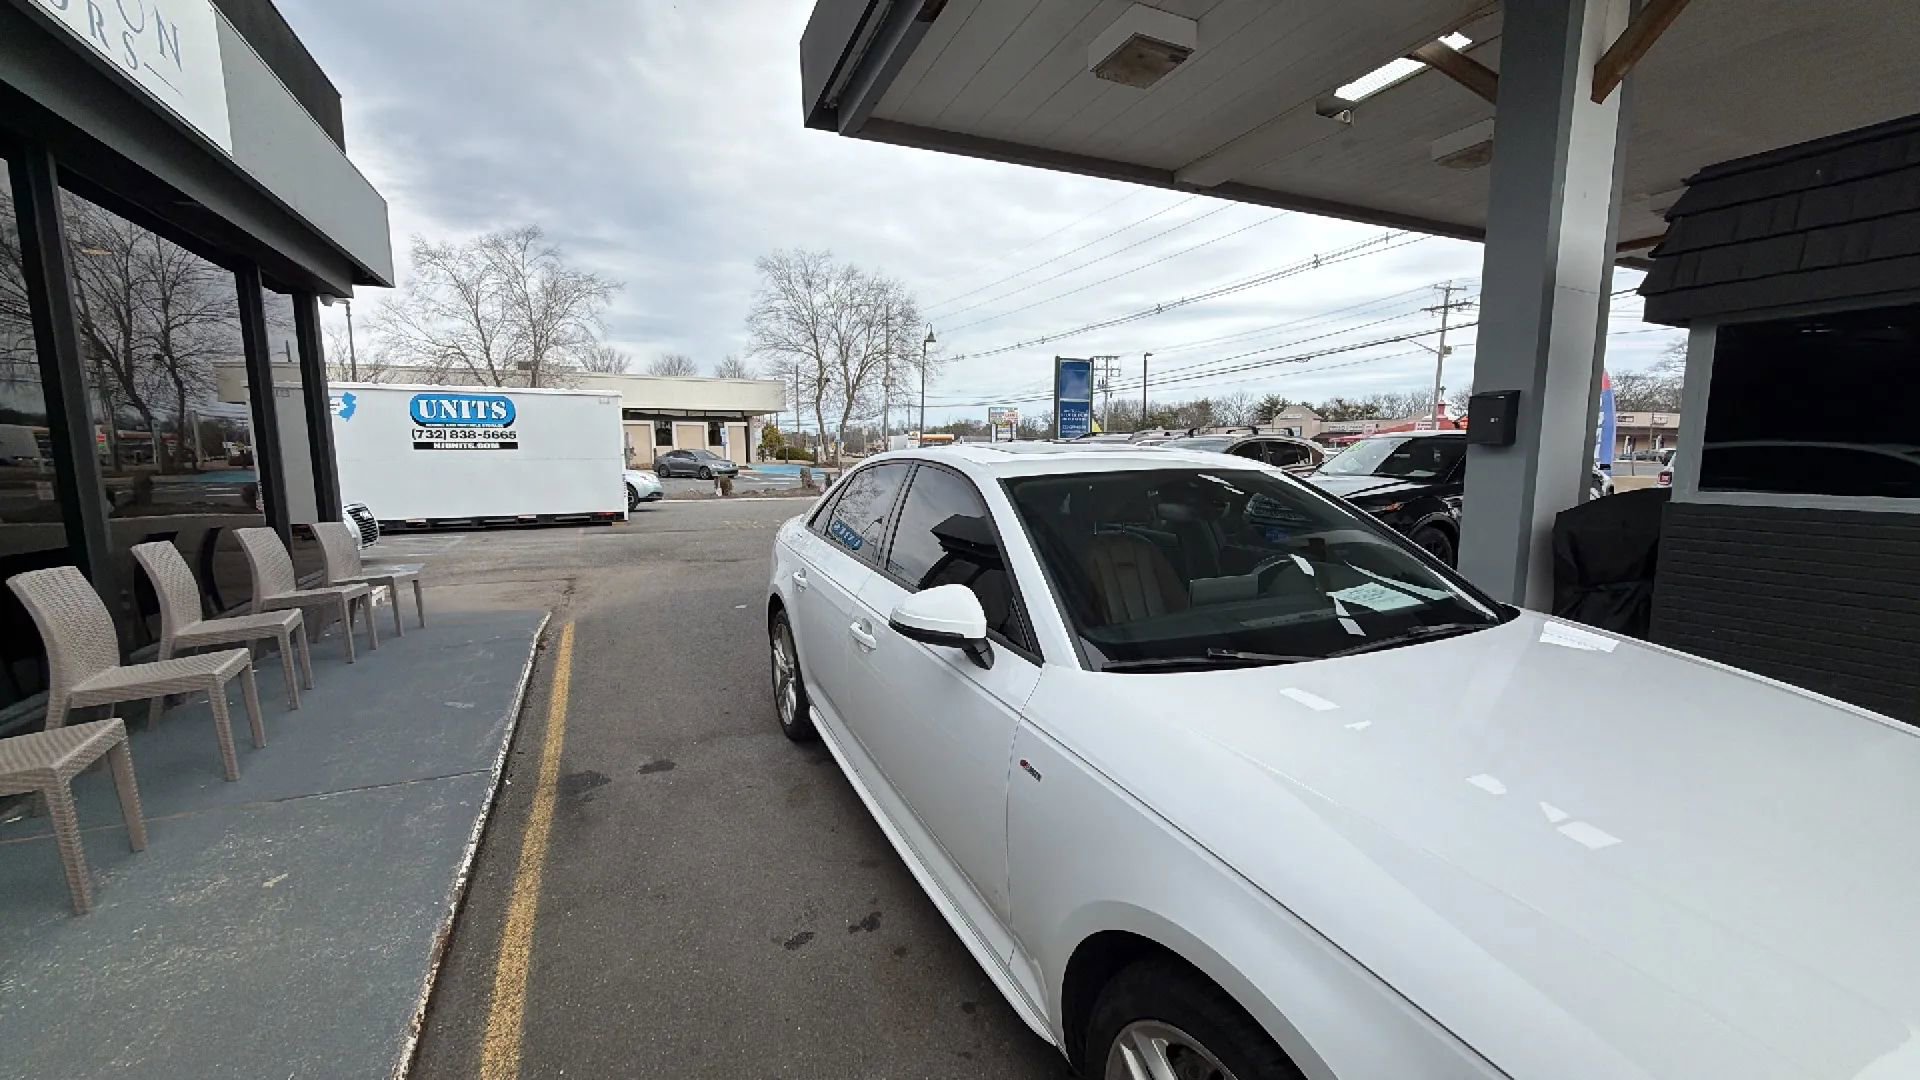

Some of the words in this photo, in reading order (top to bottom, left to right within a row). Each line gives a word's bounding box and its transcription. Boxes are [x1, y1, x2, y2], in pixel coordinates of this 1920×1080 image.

[51, 0, 138, 70] RS
[418, 399, 507, 419] UNITS
[411, 429, 447, 440] (732)
[449, 429, 517, 440] 838-5665
